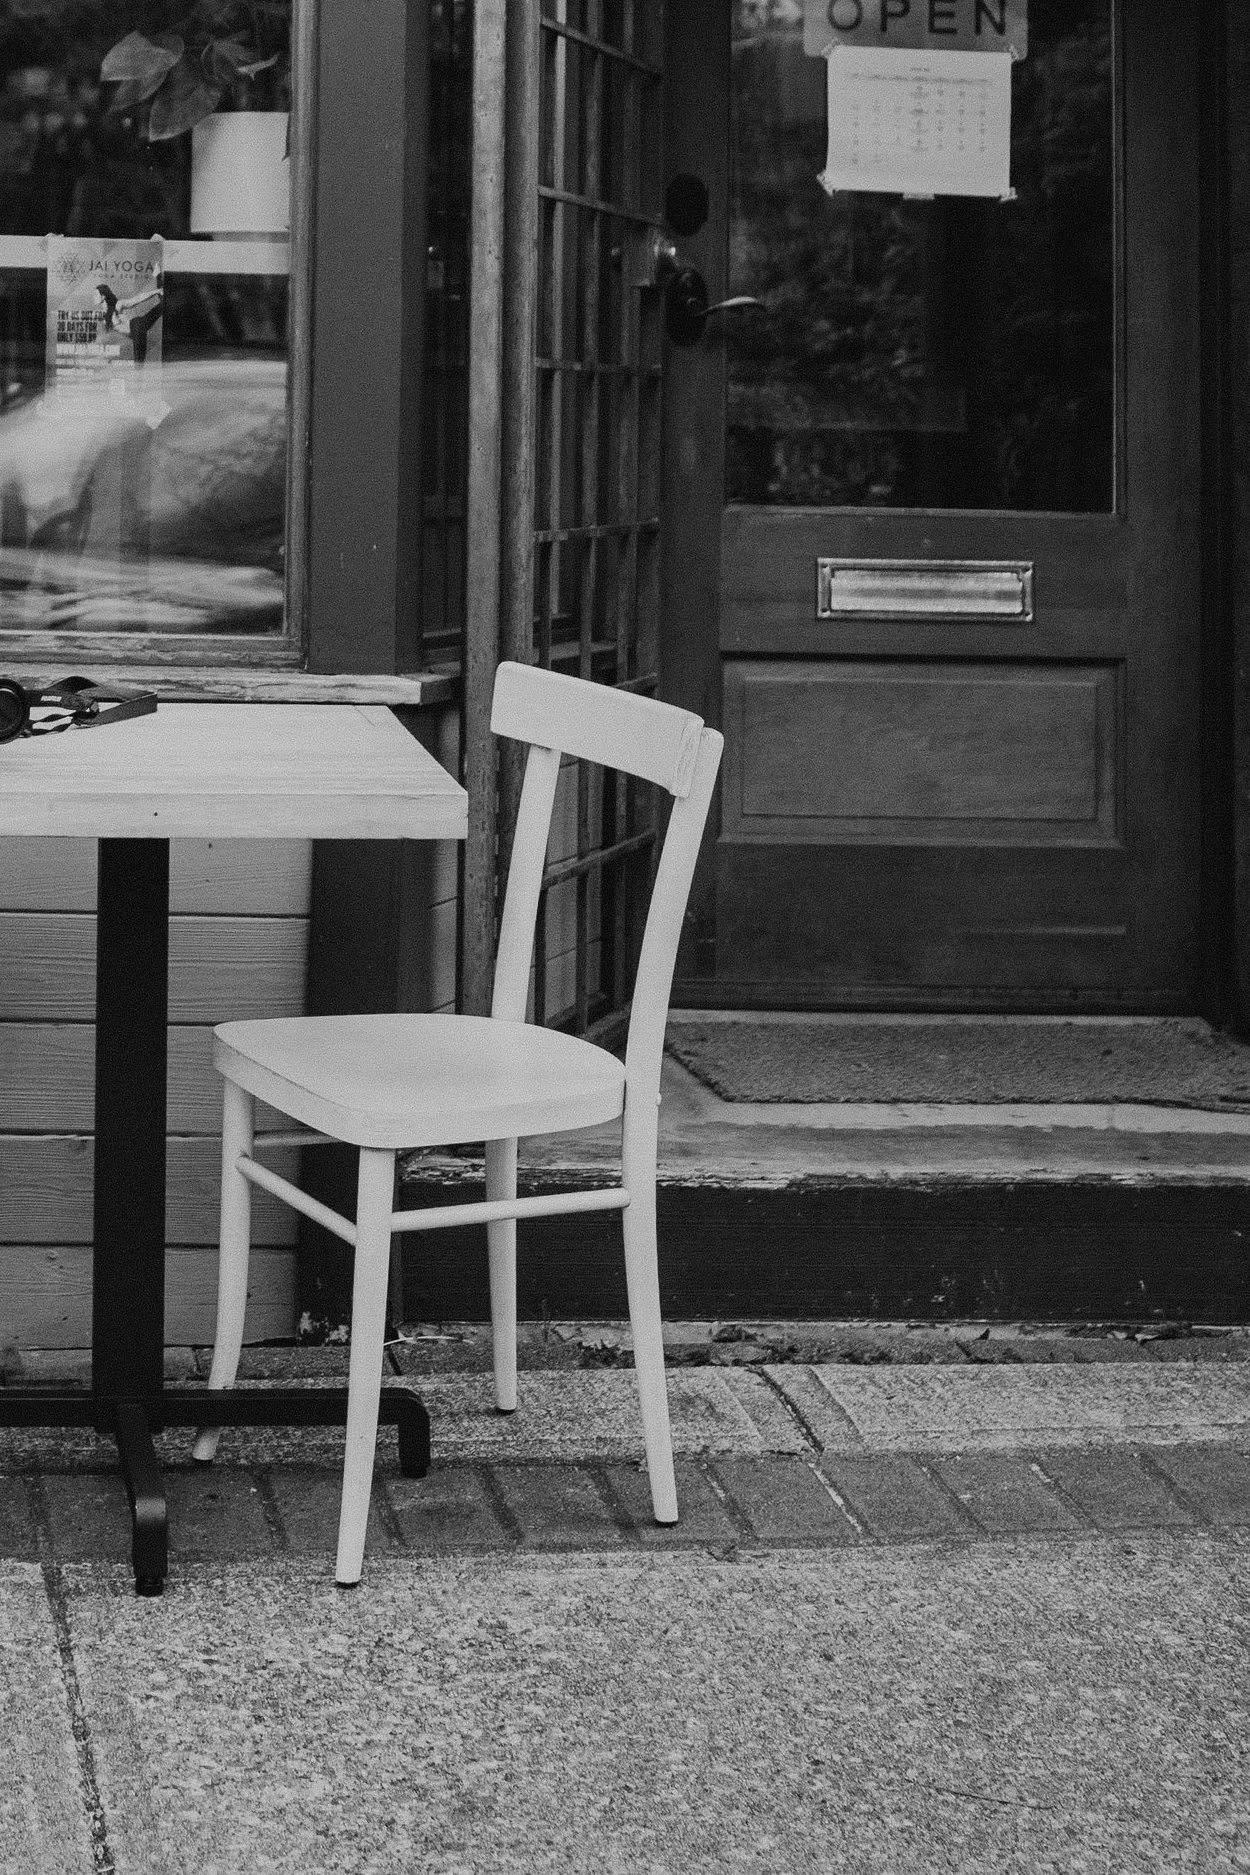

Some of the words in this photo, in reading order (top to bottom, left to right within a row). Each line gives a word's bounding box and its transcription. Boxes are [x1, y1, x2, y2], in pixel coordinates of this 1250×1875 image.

[89, 260, 108, 272] JAI
[113, 260, 154, 273] YOGA
[67, 321, 84, 332] DAYS
